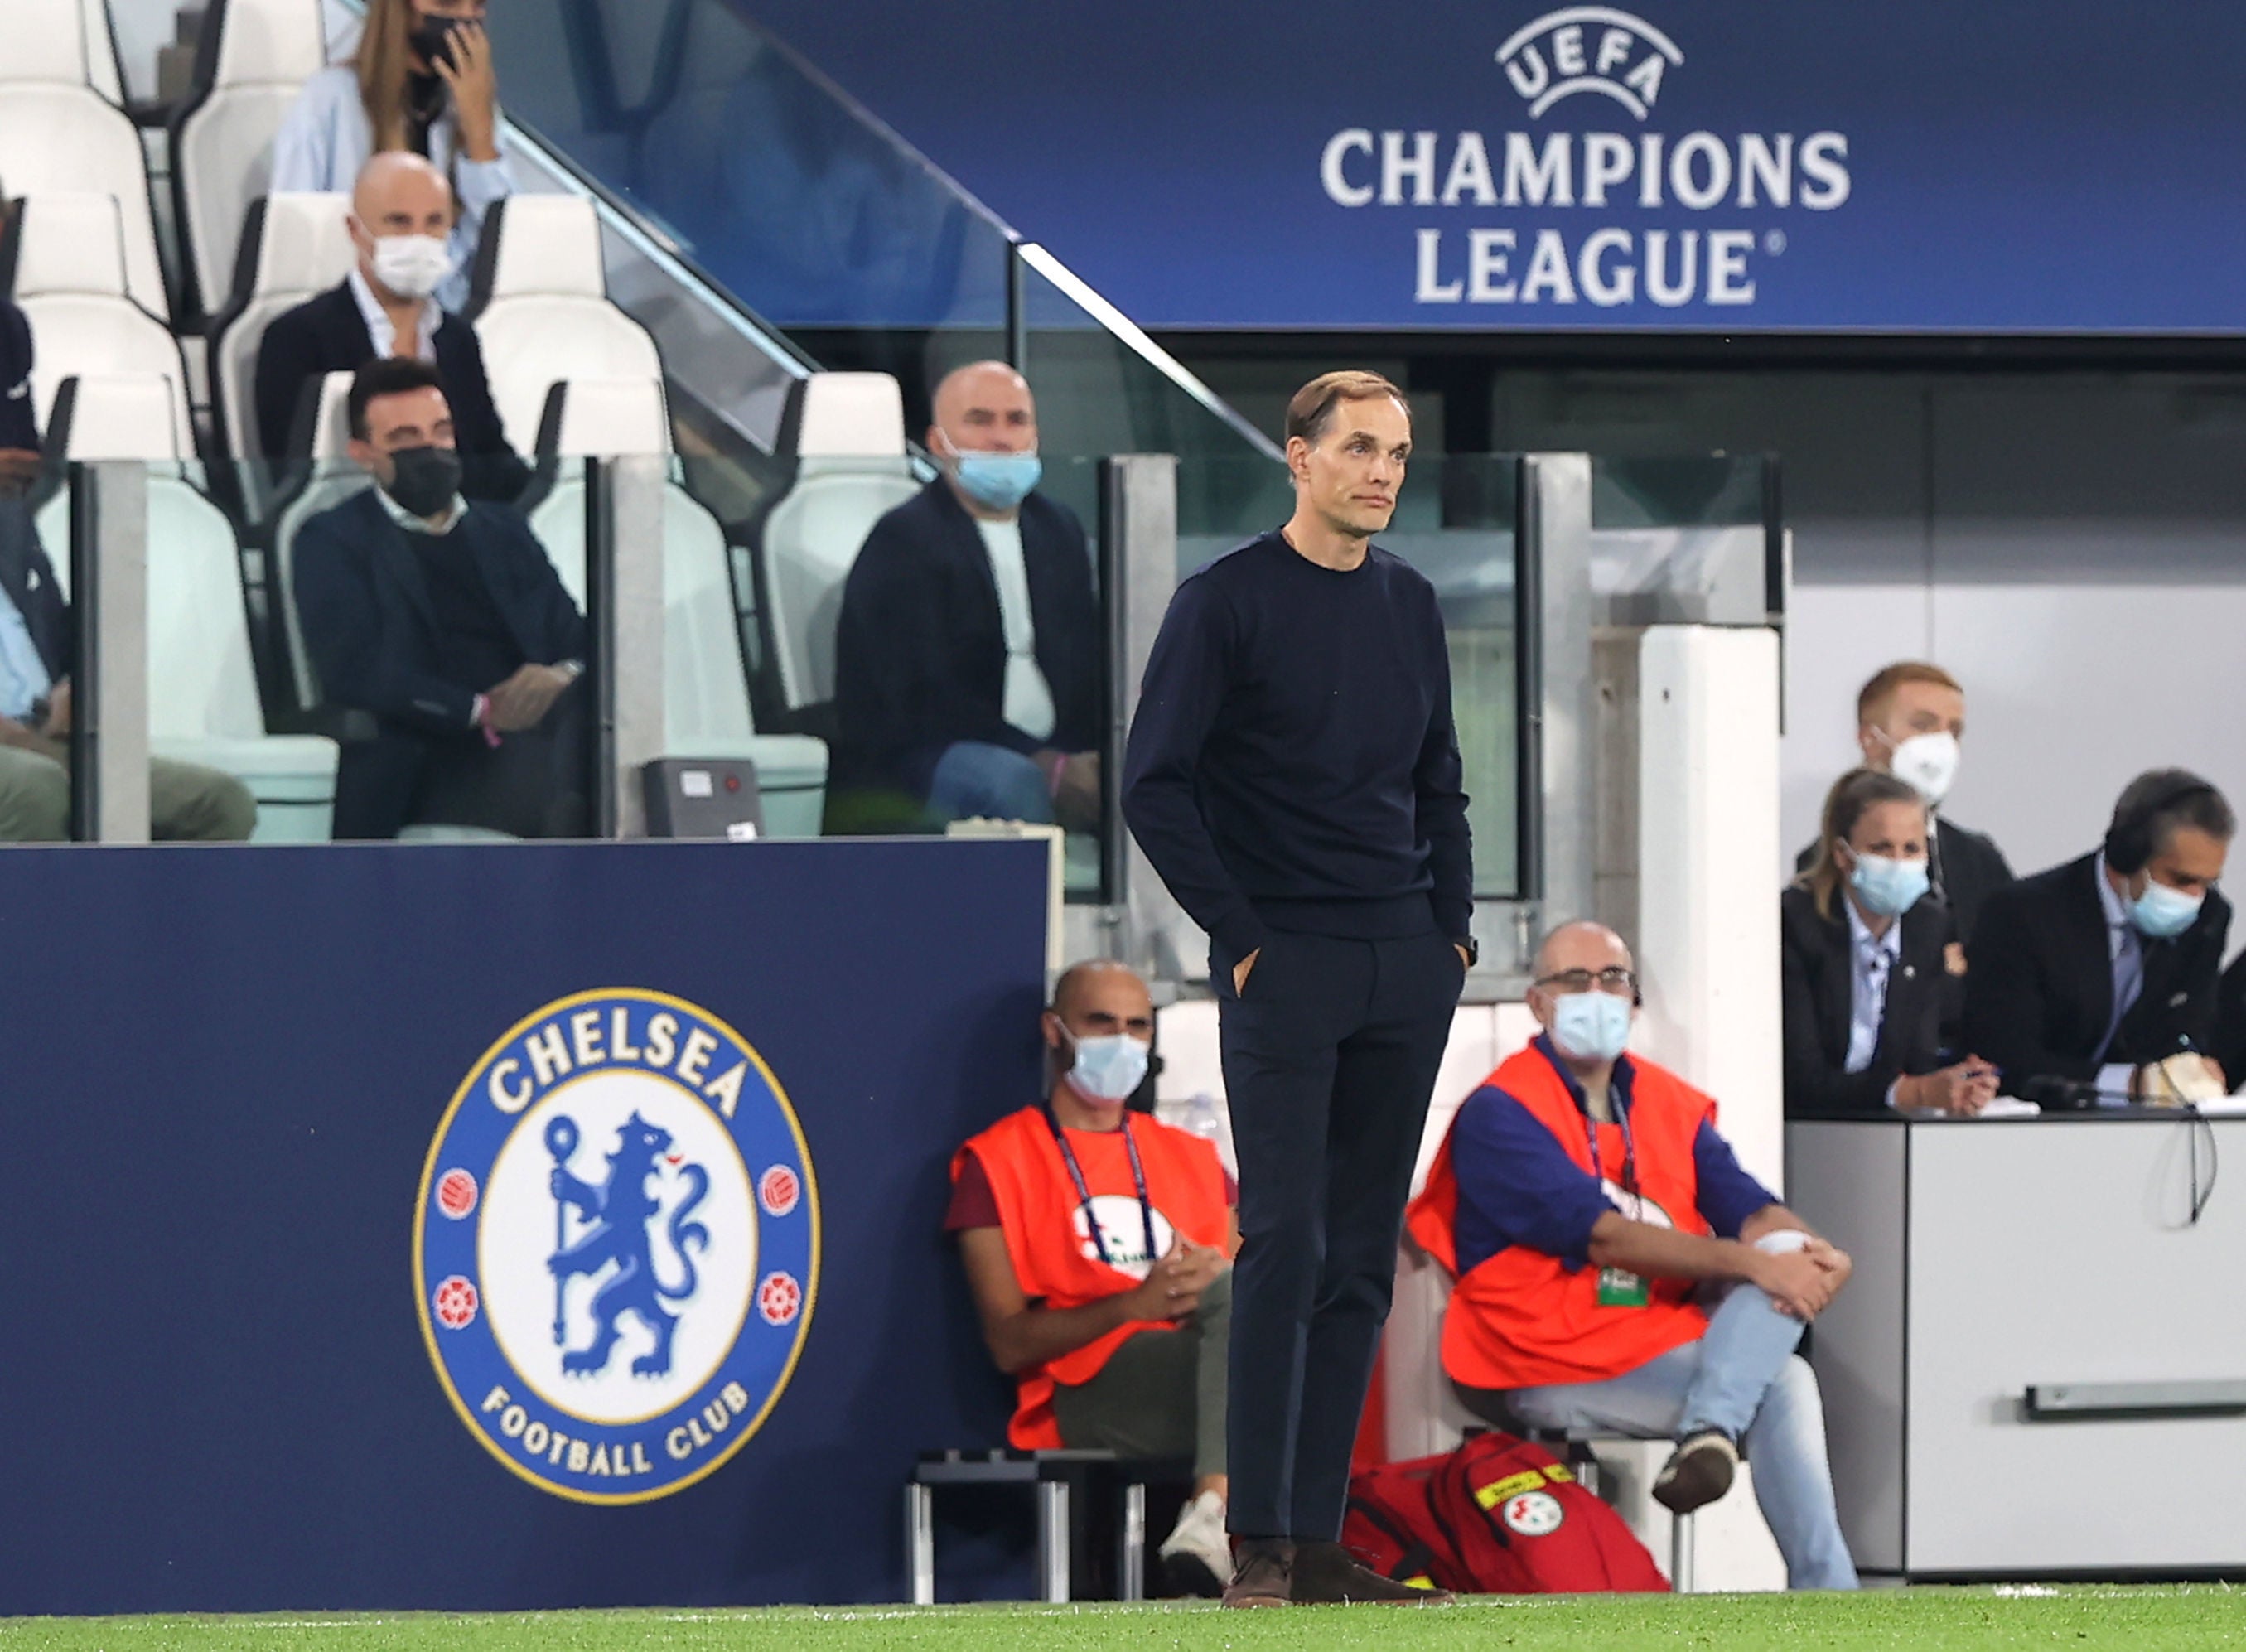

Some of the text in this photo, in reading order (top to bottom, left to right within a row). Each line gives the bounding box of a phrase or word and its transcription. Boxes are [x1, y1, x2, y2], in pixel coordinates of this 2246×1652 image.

[1506, 26, 1665, 104] UEFA
[1321, 128, 1852, 210] CHAMPIONS
[488, 1007, 747, 1118] CHELSEA
[481, 1381, 749, 1476] FOOTBALL CLUB
